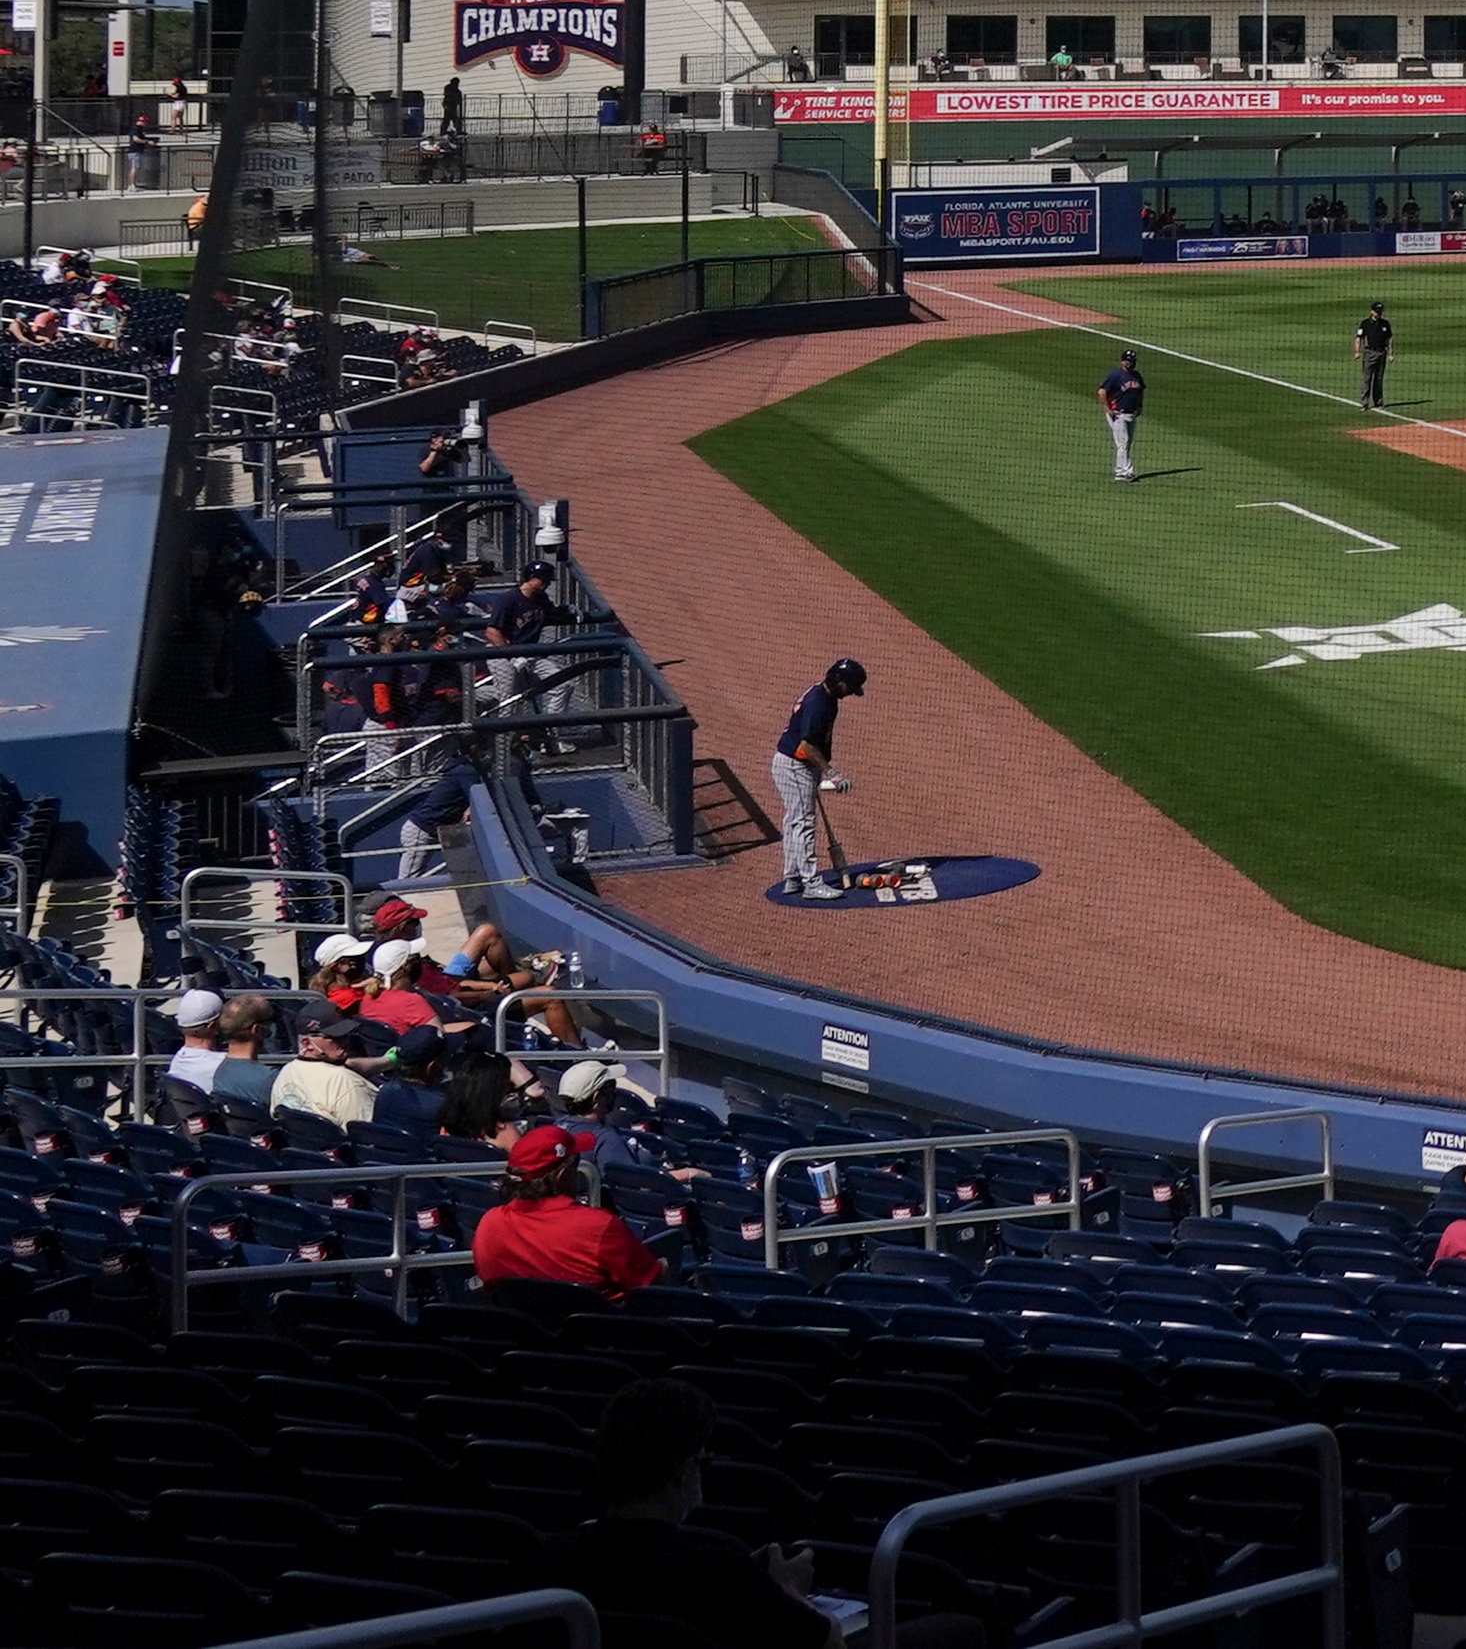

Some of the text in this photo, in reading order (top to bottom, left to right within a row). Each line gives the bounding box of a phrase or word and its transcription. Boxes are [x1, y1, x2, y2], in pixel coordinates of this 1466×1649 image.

[462, 7, 618, 48] CHAMPIONS
[804, 96, 836, 107] TIRE
[947, 93, 1271, 110] LOWEST TIRE PRICE GUARANTEE
[1301, 93, 1446, 107] It's our promise to you.
[804, 109, 851, 119] SERVICE
[944, 199, 1090, 212] FLORIDA ATLANTIC UNIVERSITY
[940, 209, 1093, 238] MBA SPORT
[959, 236, 1075, 248] MBASPORT.FAU.EDU
[822, 1025, 869, 1047] ATTENTION
